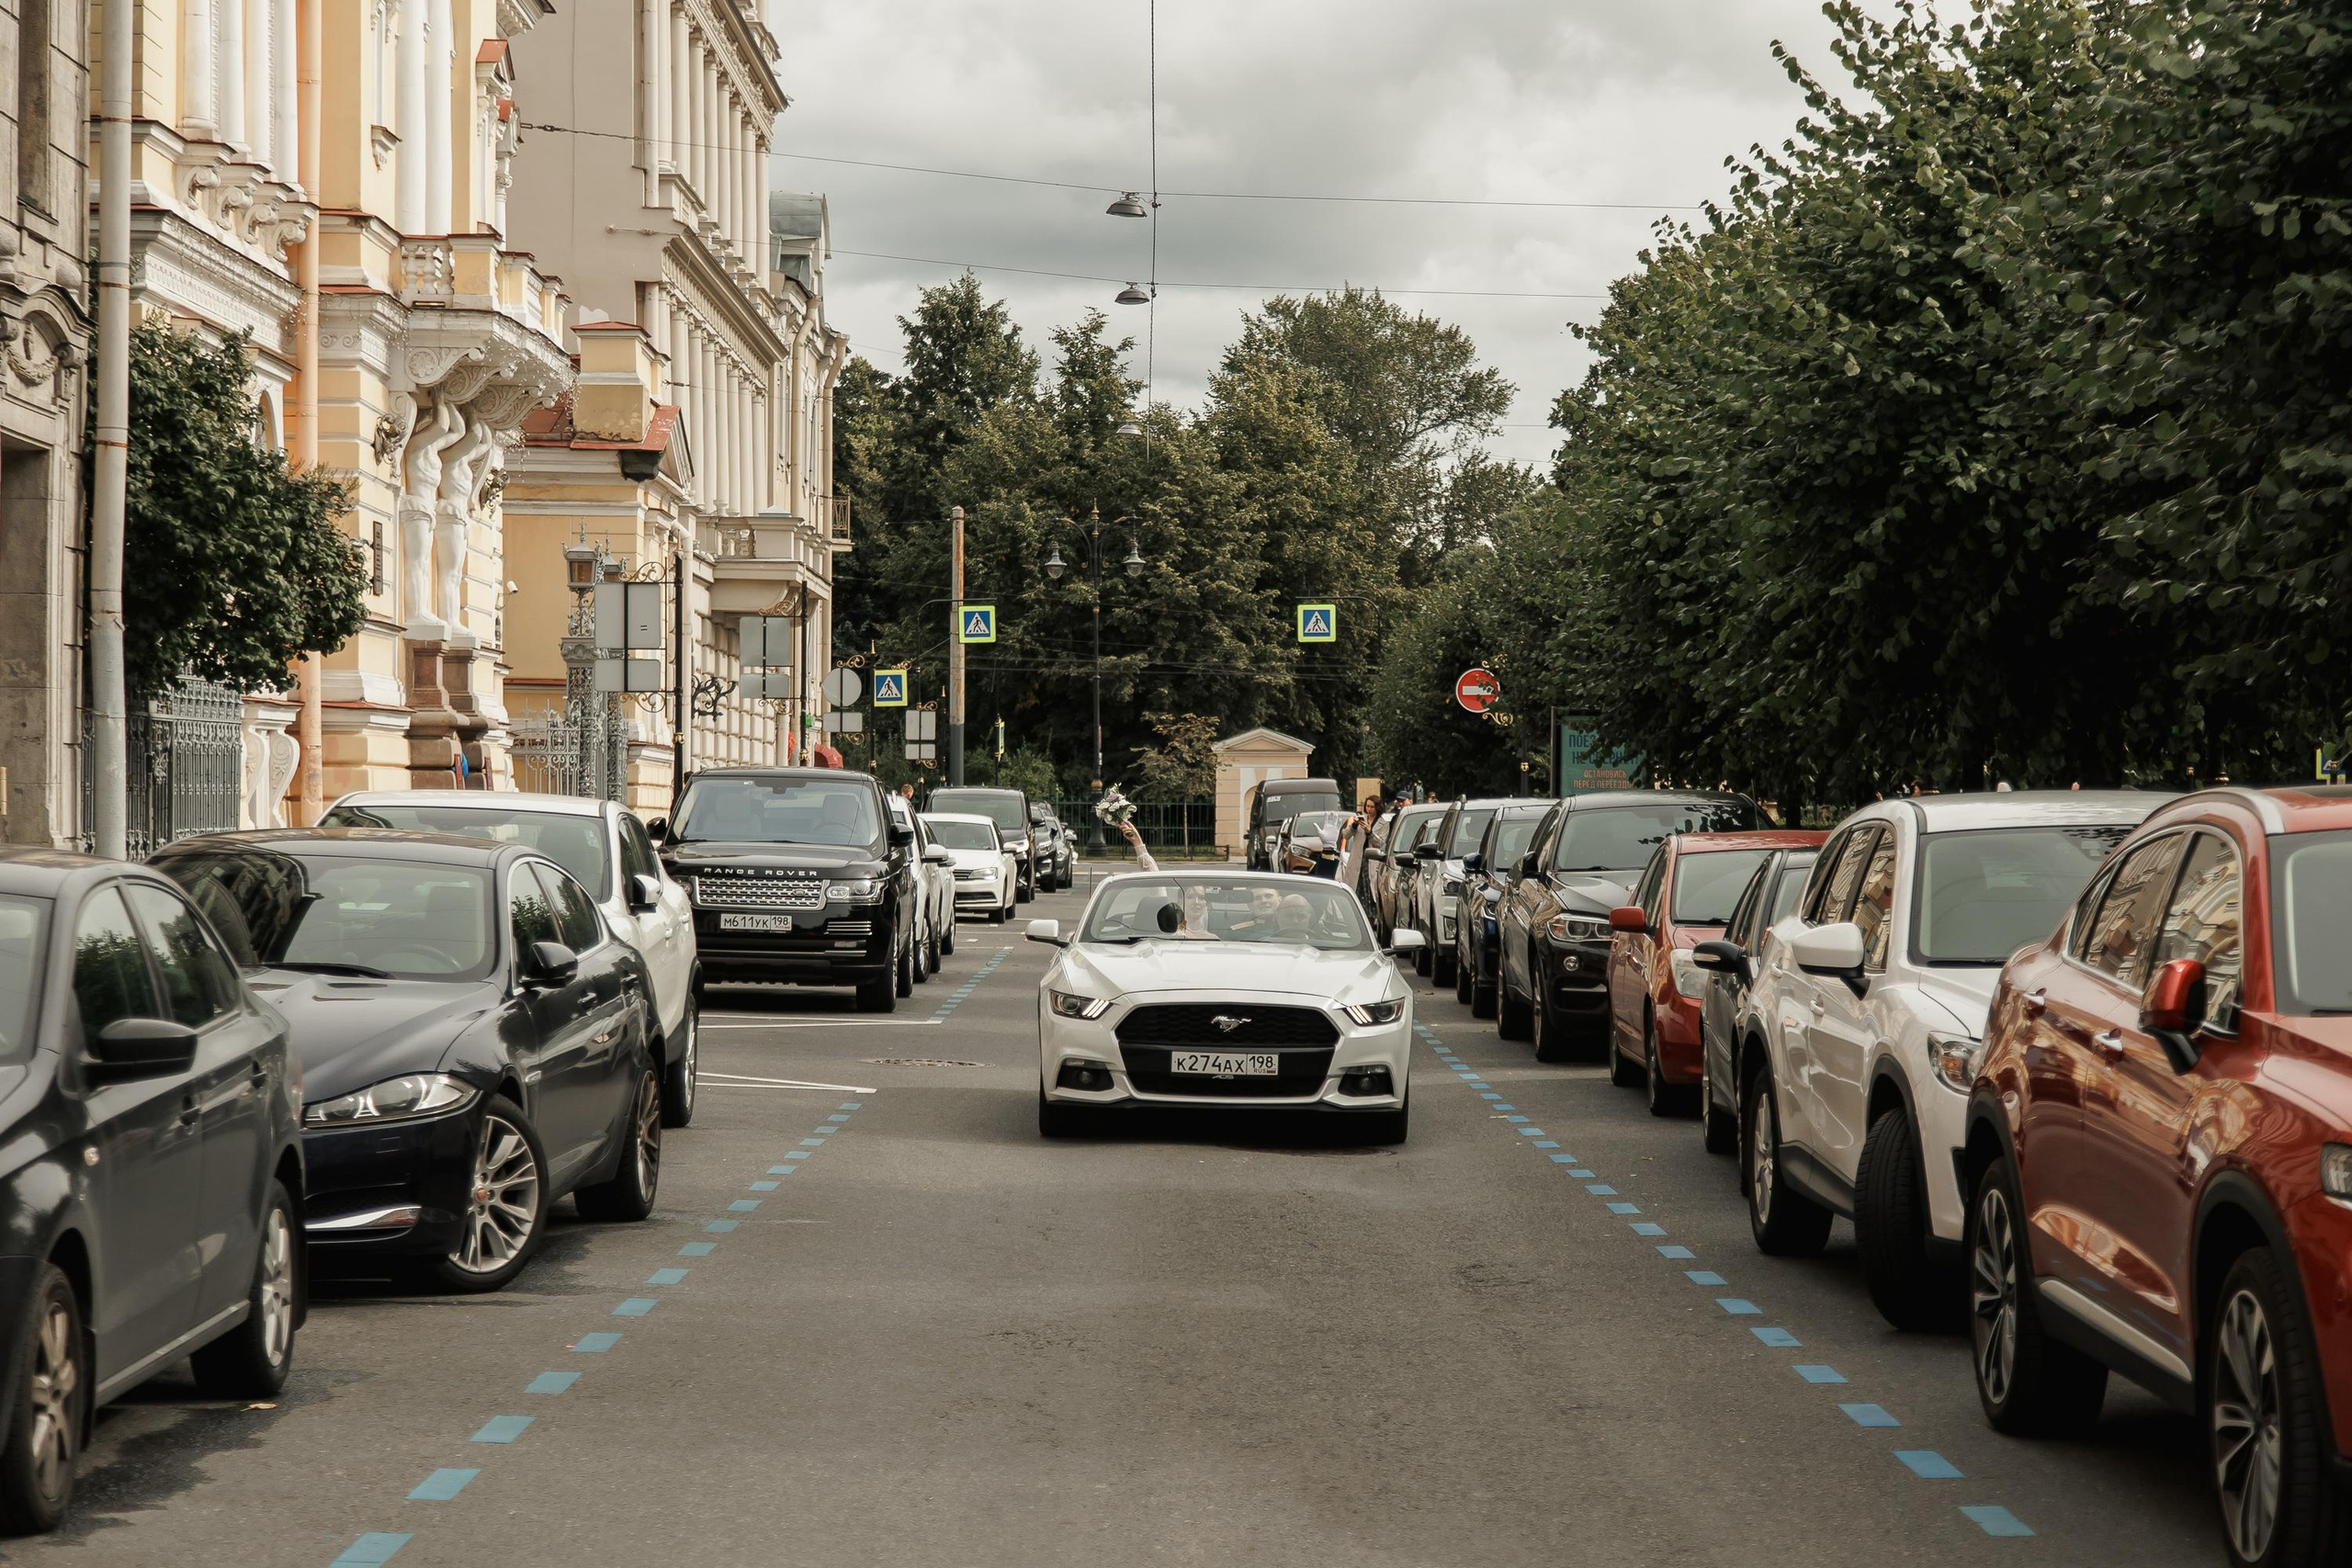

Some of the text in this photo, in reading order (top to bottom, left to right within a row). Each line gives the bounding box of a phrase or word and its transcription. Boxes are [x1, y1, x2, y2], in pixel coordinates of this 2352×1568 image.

[1584, 770, 1627, 778] ОСТАНОВИСЬ
[1574, 780, 1595, 789] ПЕРЕД
[704, 867, 755, 875] RANGE
[772, 916, 788, 926] 198
[1177, 1055, 1273, 1073] К274АХ 198
